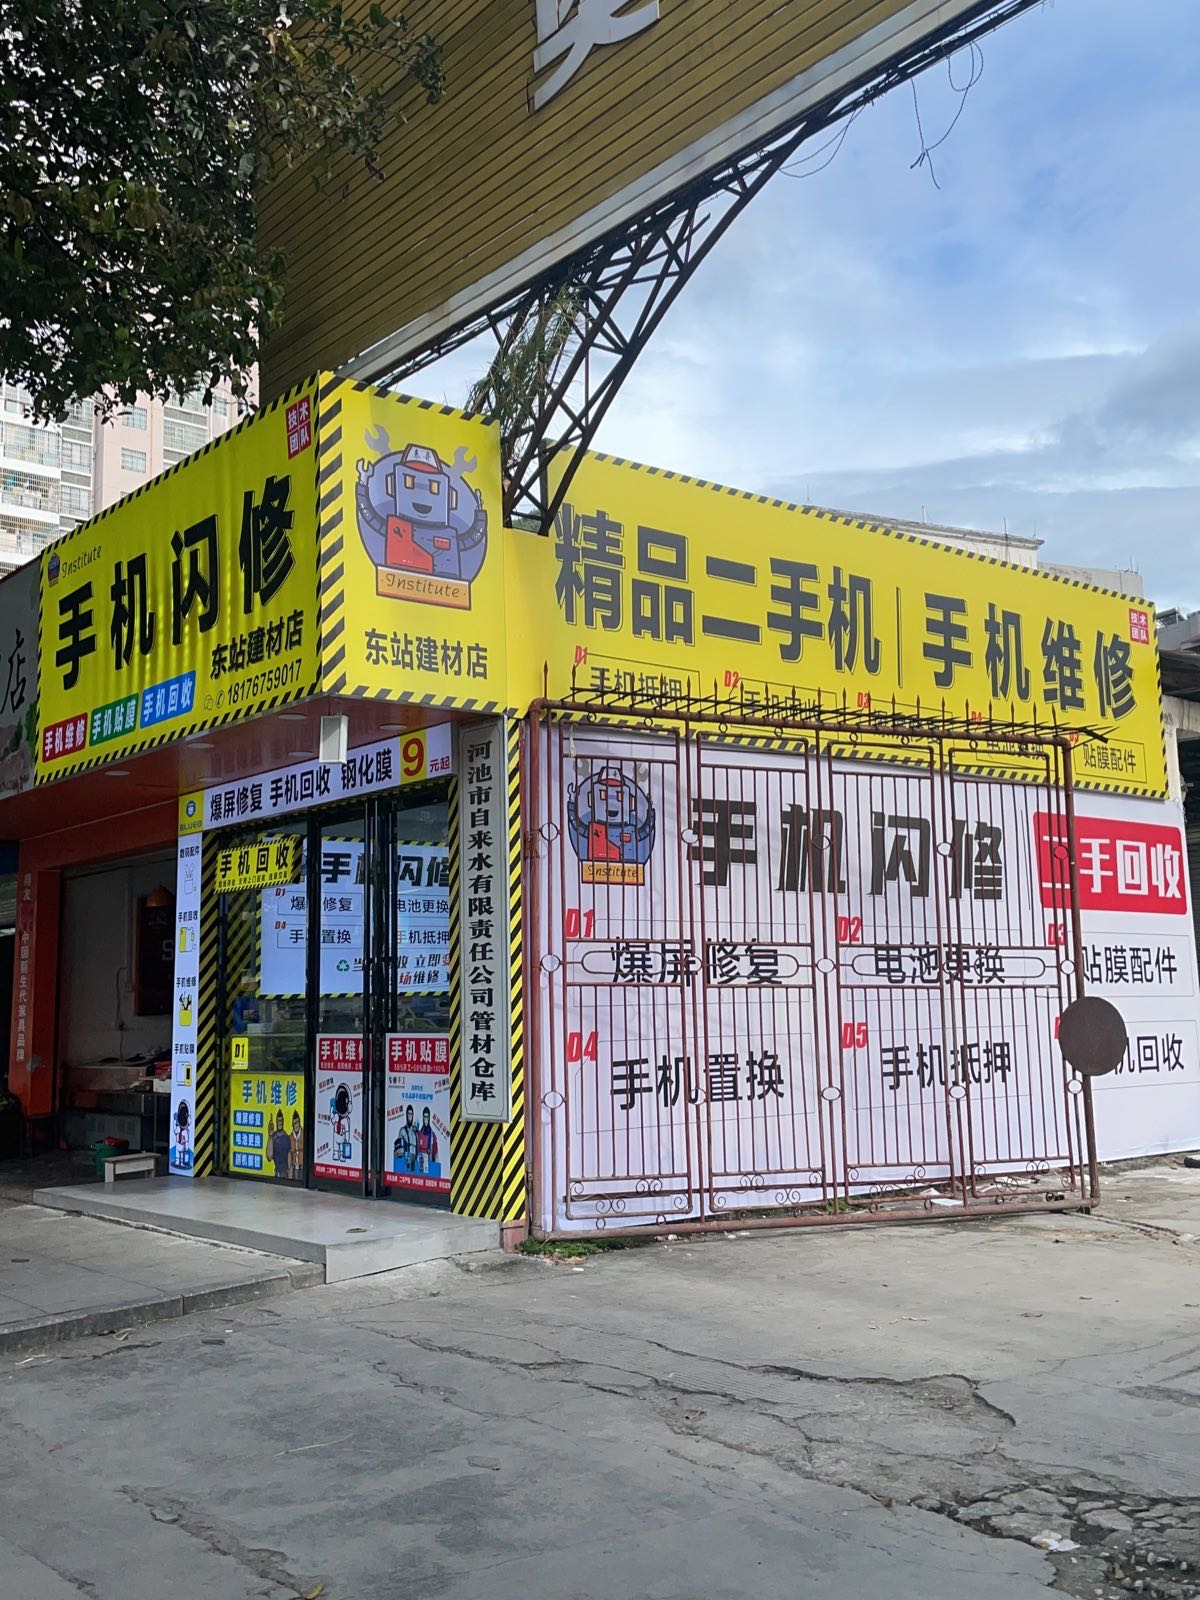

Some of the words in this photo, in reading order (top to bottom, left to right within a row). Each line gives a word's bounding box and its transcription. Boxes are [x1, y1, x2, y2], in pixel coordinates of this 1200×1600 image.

[56, 474, 296, 690] 手机闪修
[62, 546, 101, 578] Institute
[385, 573, 460, 598] Institute
[554, 503, 882, 676] 精品二手机
[922, 592, 1137, 720] 手机维修
[1131, 612, 1146, 625] 技术
[210, 609, 304, 680] 东站建材店
[365, 628, 487, 680] 东站建材店
[1131, 627, 1147, 641] 团队
[143, 677, 193, 722] 手机回收
[228, 658, 302, 706] 18176759017
[44, 718, 86, 757] 手机维修
[92, 700, 136, 741] 手机贴膜
[1083, 743, 1136, 773] 贴膜配件
[210, 783, 262, 822] 爆屏修复
[270, 765, 331, 808] 手机回收
[341, 748, 392, 790] 钢化膜
[402, 738, 424, 777] 9
[430, 755, 451, 773] 元起
[220, 843, 289, 878] 手机回收
[687, 798, 1002, 901] 手机闪修
[1042, 835, 1182, 899] 二手回收
[291, 896, 352, 912] 爆修复
[467, 740, 496, 1102] 河池市自来水有限责任公司管材仓库
[289, 930, 351, 945] 手置换
[611, 936, 782, 987] 爆屏修复
[874, 942, 1005, 984] 电池更换
[1082, 944, 1177, 984] 贴膜配件
[391, 1041, 447, 1062] 手机贴膜
[882, 1040, 1011, 1091] 手机抵押
[242, 1080, 297, 1106] 手机维修
[610, 1050, 784, 1110] 手机置换
